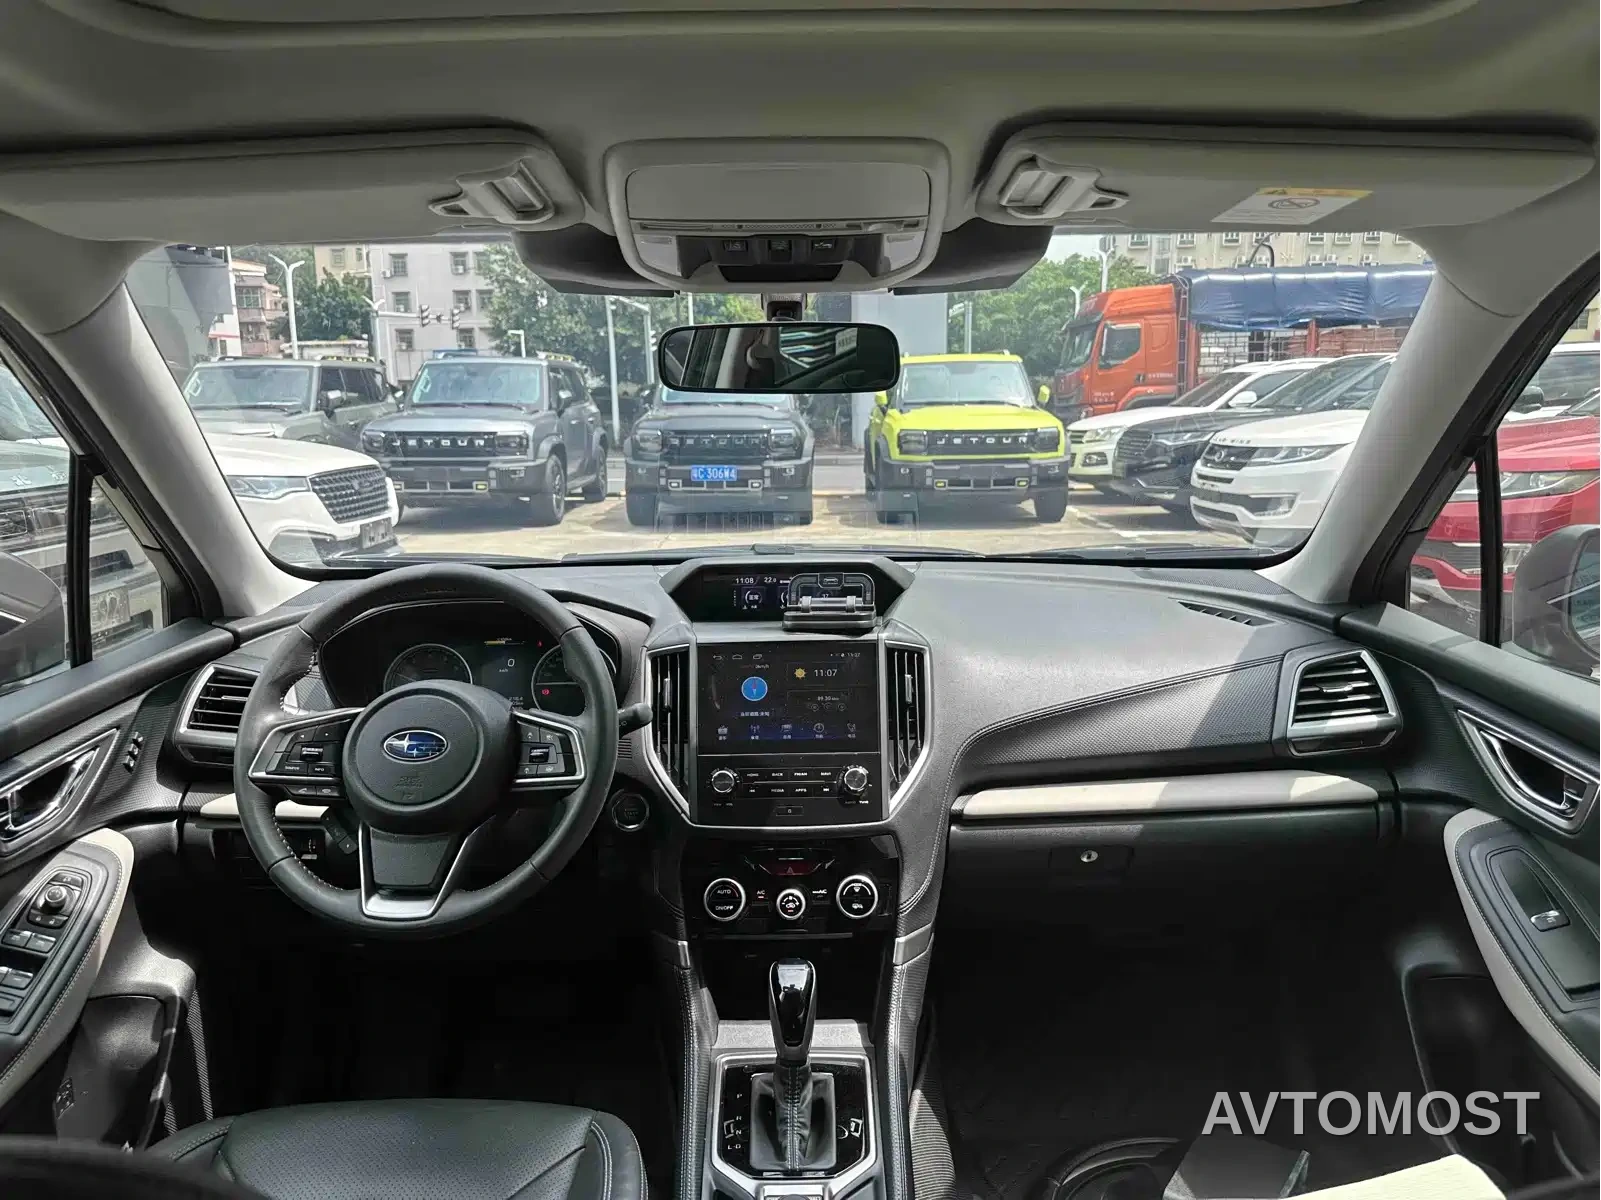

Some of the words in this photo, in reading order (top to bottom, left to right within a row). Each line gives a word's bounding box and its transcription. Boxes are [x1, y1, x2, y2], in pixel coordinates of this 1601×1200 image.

[391, 438, 485, 447] JETOUR
[936, 436, 1028, 445] JETOUR
[813, 668, 838, 677] 11:07
